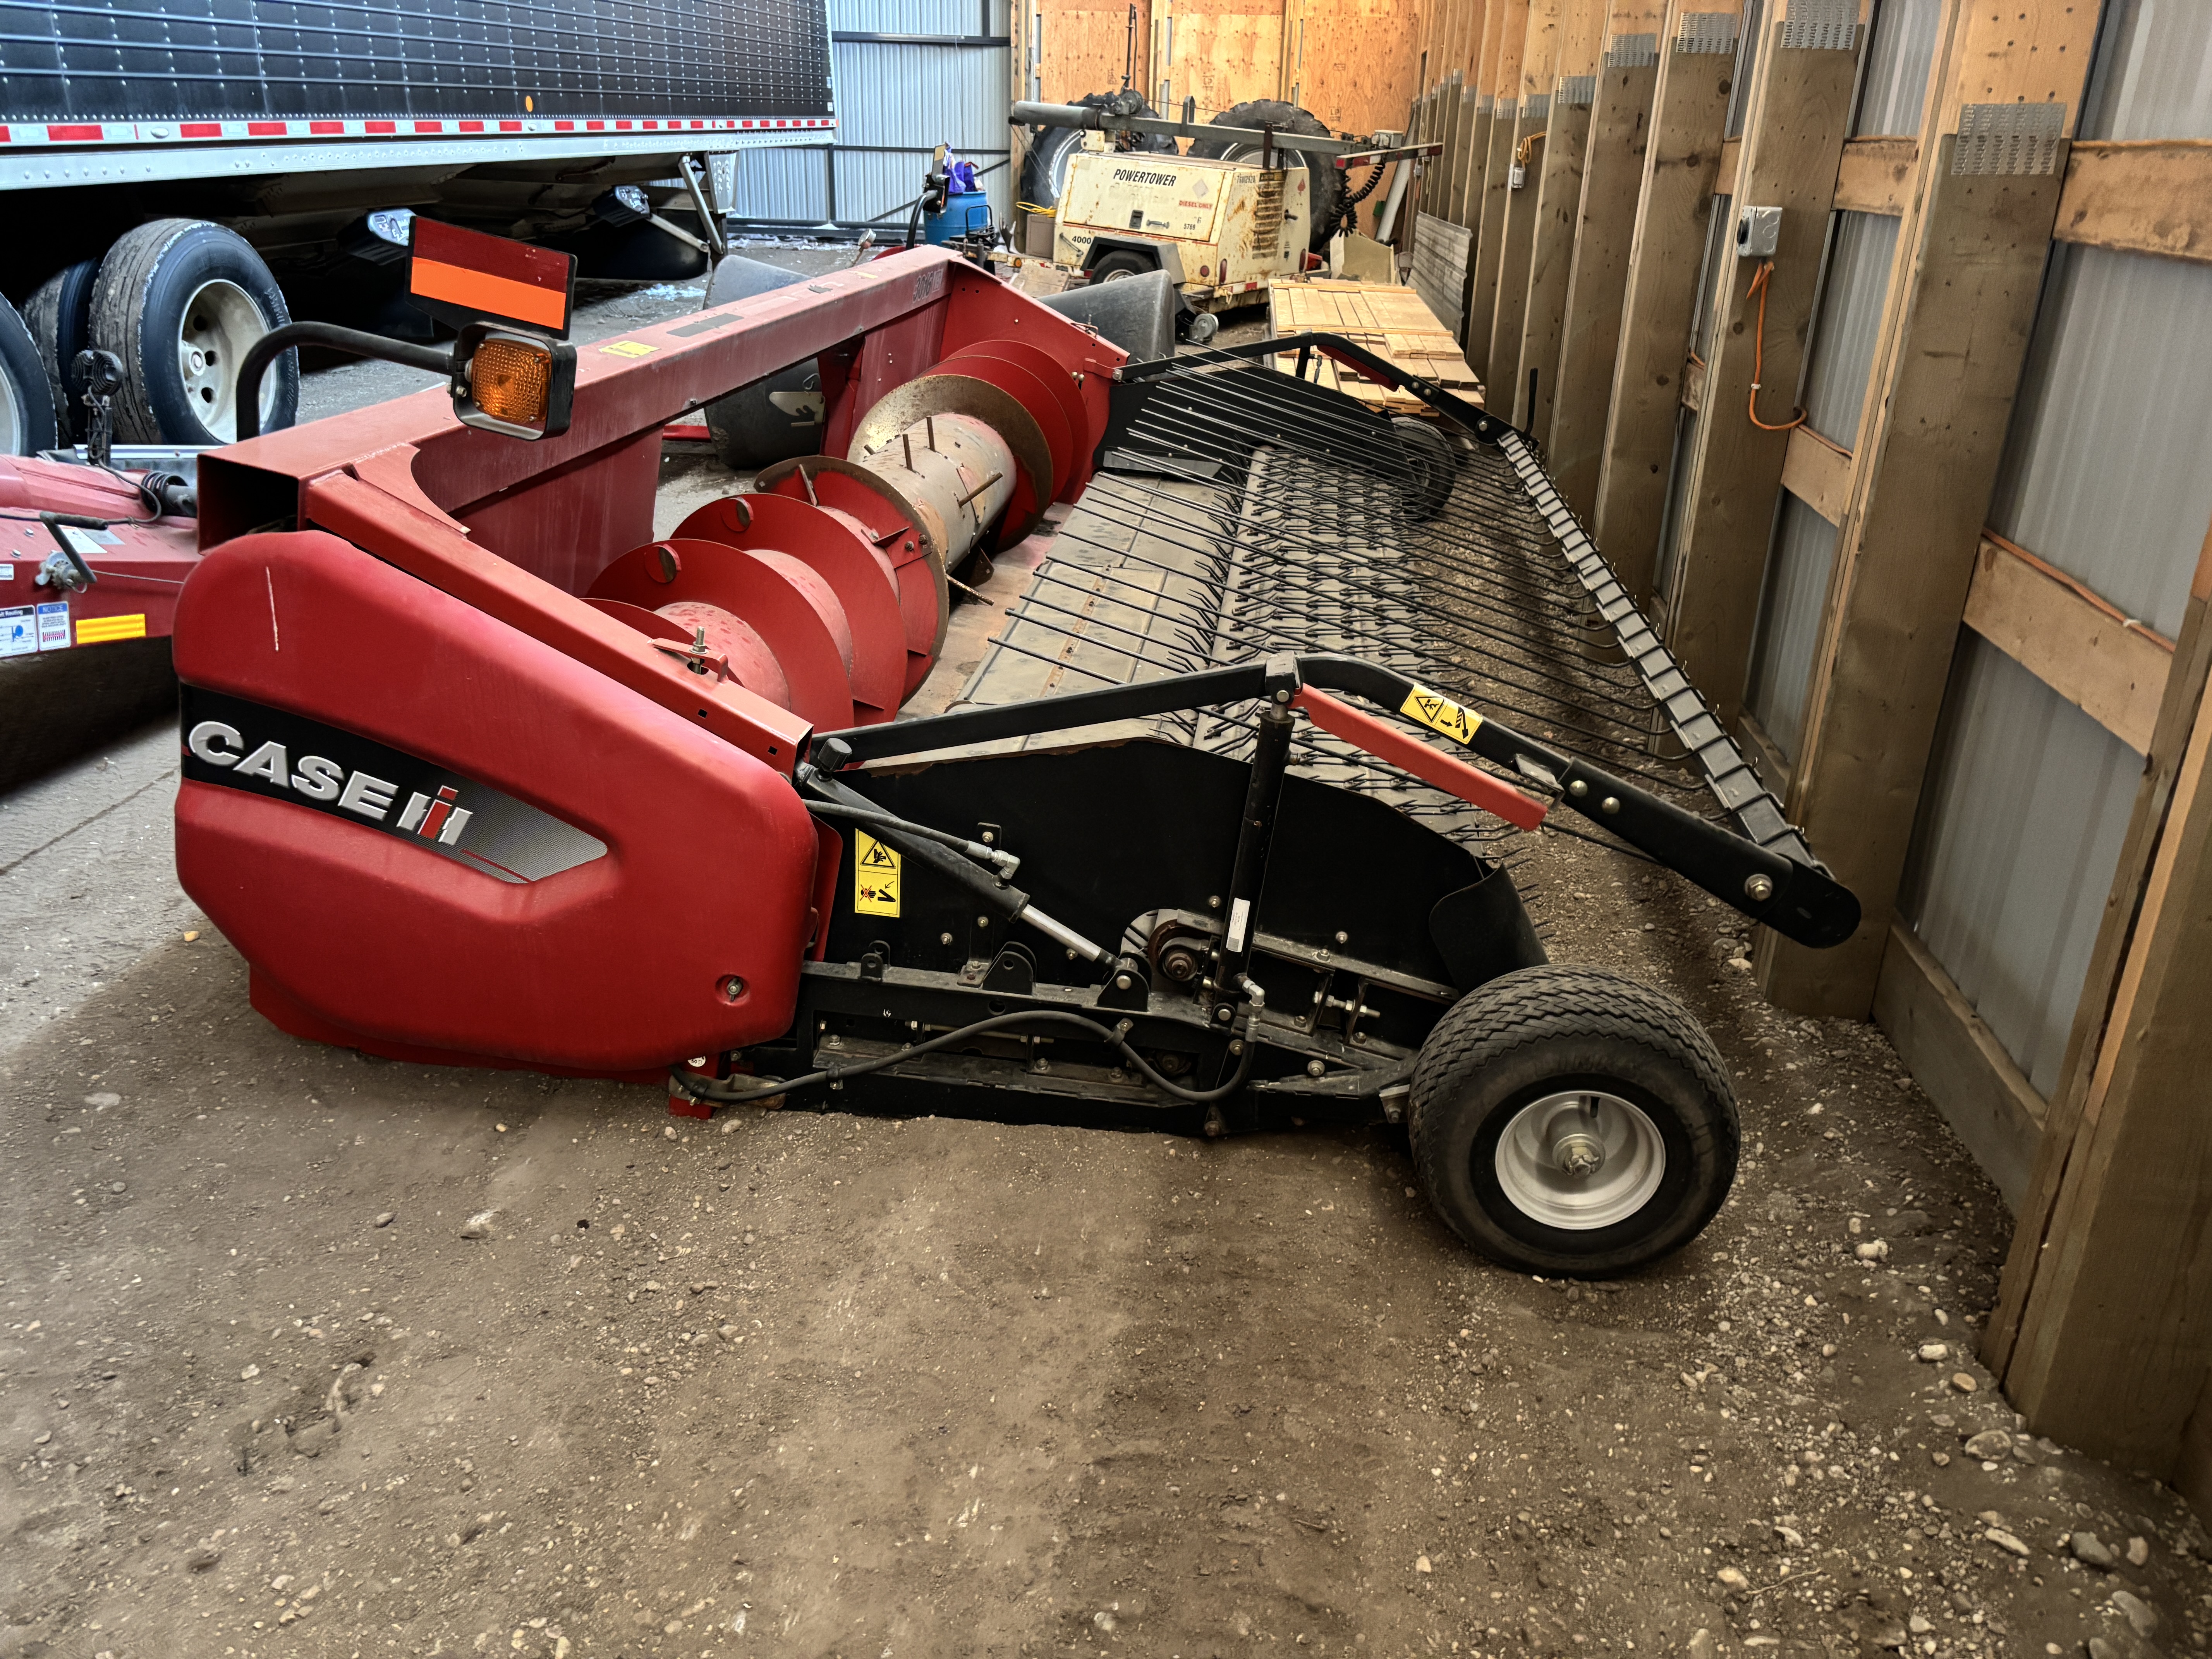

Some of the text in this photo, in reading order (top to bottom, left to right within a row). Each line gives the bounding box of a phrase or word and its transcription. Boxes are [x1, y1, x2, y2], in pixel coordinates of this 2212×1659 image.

[1113, 168, 1176, 187] POWERTOWER
[1072, 235, 1091, 244] 4000
[189, 721, 399, 821] CASE
